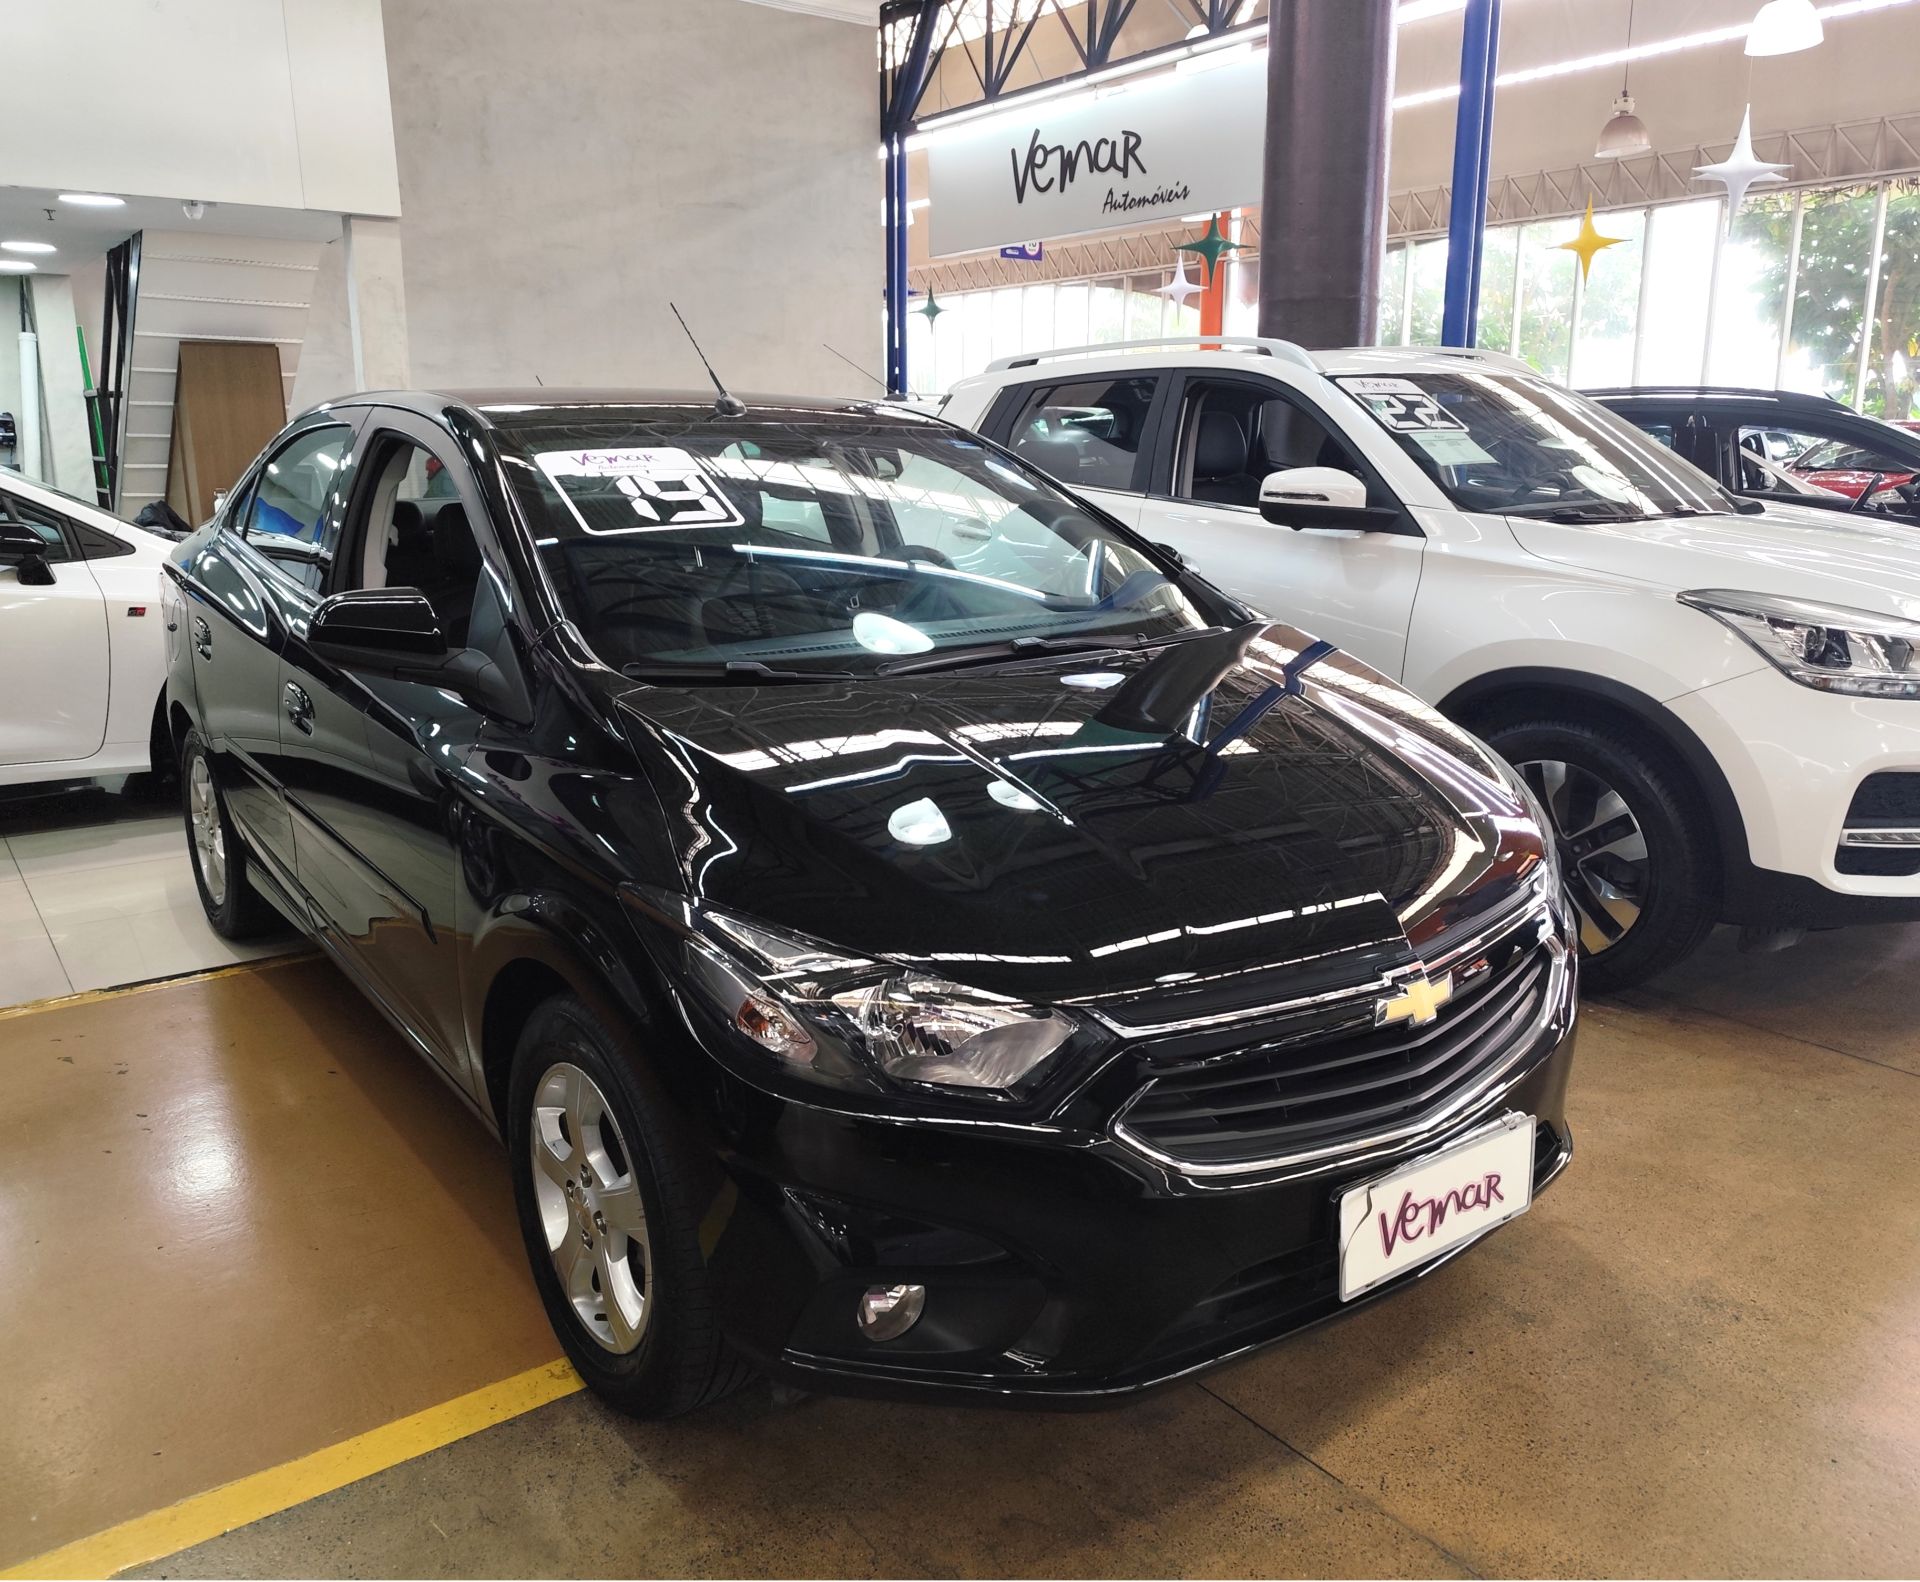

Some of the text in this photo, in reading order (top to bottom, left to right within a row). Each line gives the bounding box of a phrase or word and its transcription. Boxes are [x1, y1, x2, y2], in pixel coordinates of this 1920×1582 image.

[1101, 181, 1191, 214] Automóveis
[1362, 394, 1460, 429] 22
[615, 475, 728, 522] 19
